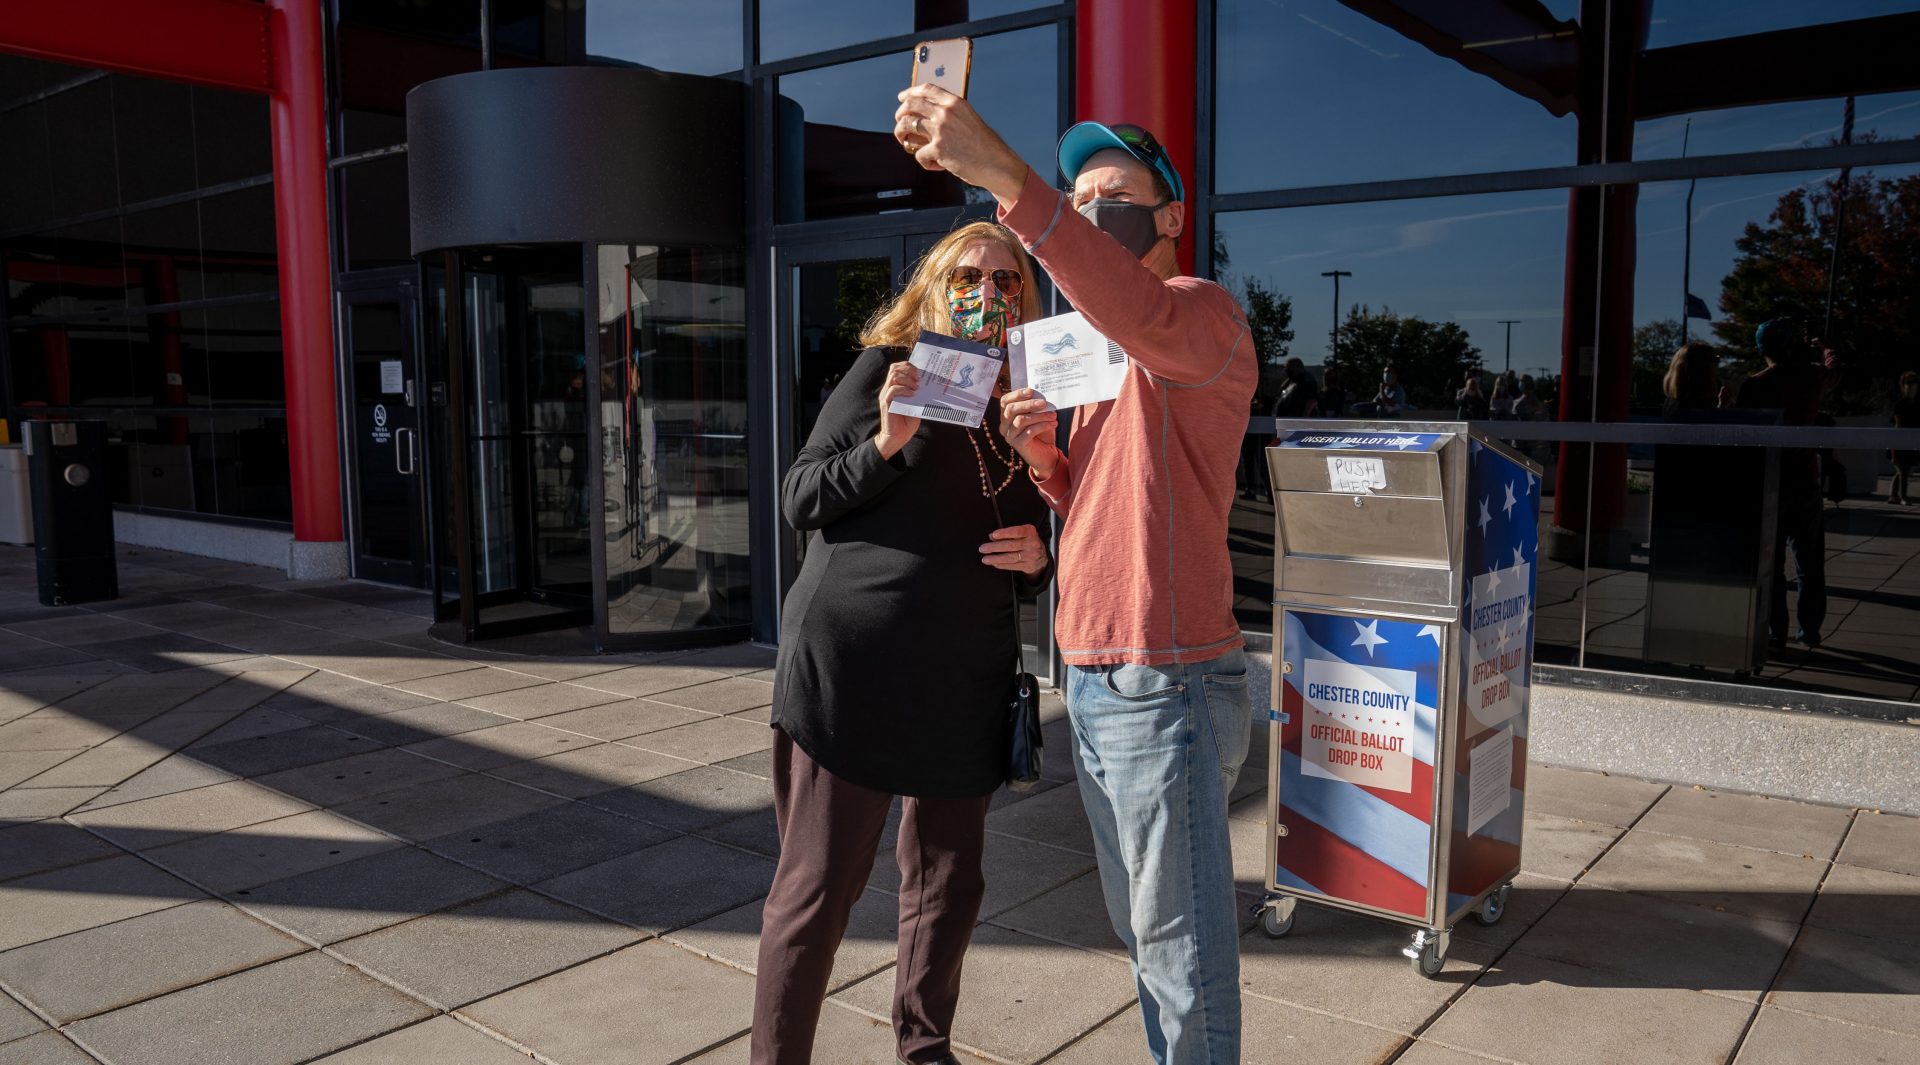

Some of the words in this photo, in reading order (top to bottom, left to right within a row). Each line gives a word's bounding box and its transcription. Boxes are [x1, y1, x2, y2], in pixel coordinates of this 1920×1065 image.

[1300, 436, 1343, 444] INSERT
[1340, 437, 1387, 445] BALLOT
[1335, 458, 1376, 477] PUSH
[1472, 602, 1502, 630] CHESTER
[1502, 594, 1527, 621] COUNTY
[1472, 656, 1499, 685] OFFICIAL
[1500, 648, 1522, 674] BALLOT
[1309, 683, 1360, 705] CHESTER
[1362, 690, 1410, 712] COUNTY
[1481, 685, 1498, 709] DROP
[1498, 679, 1511, 702] BOX
[1310, 724, 1358, 746] OFFICIAL
[1361, 731, 1405, 753] BALLOT
[1328, 748, 1358, 766] DROP
[1360, 753, 1384, 771] BOX
